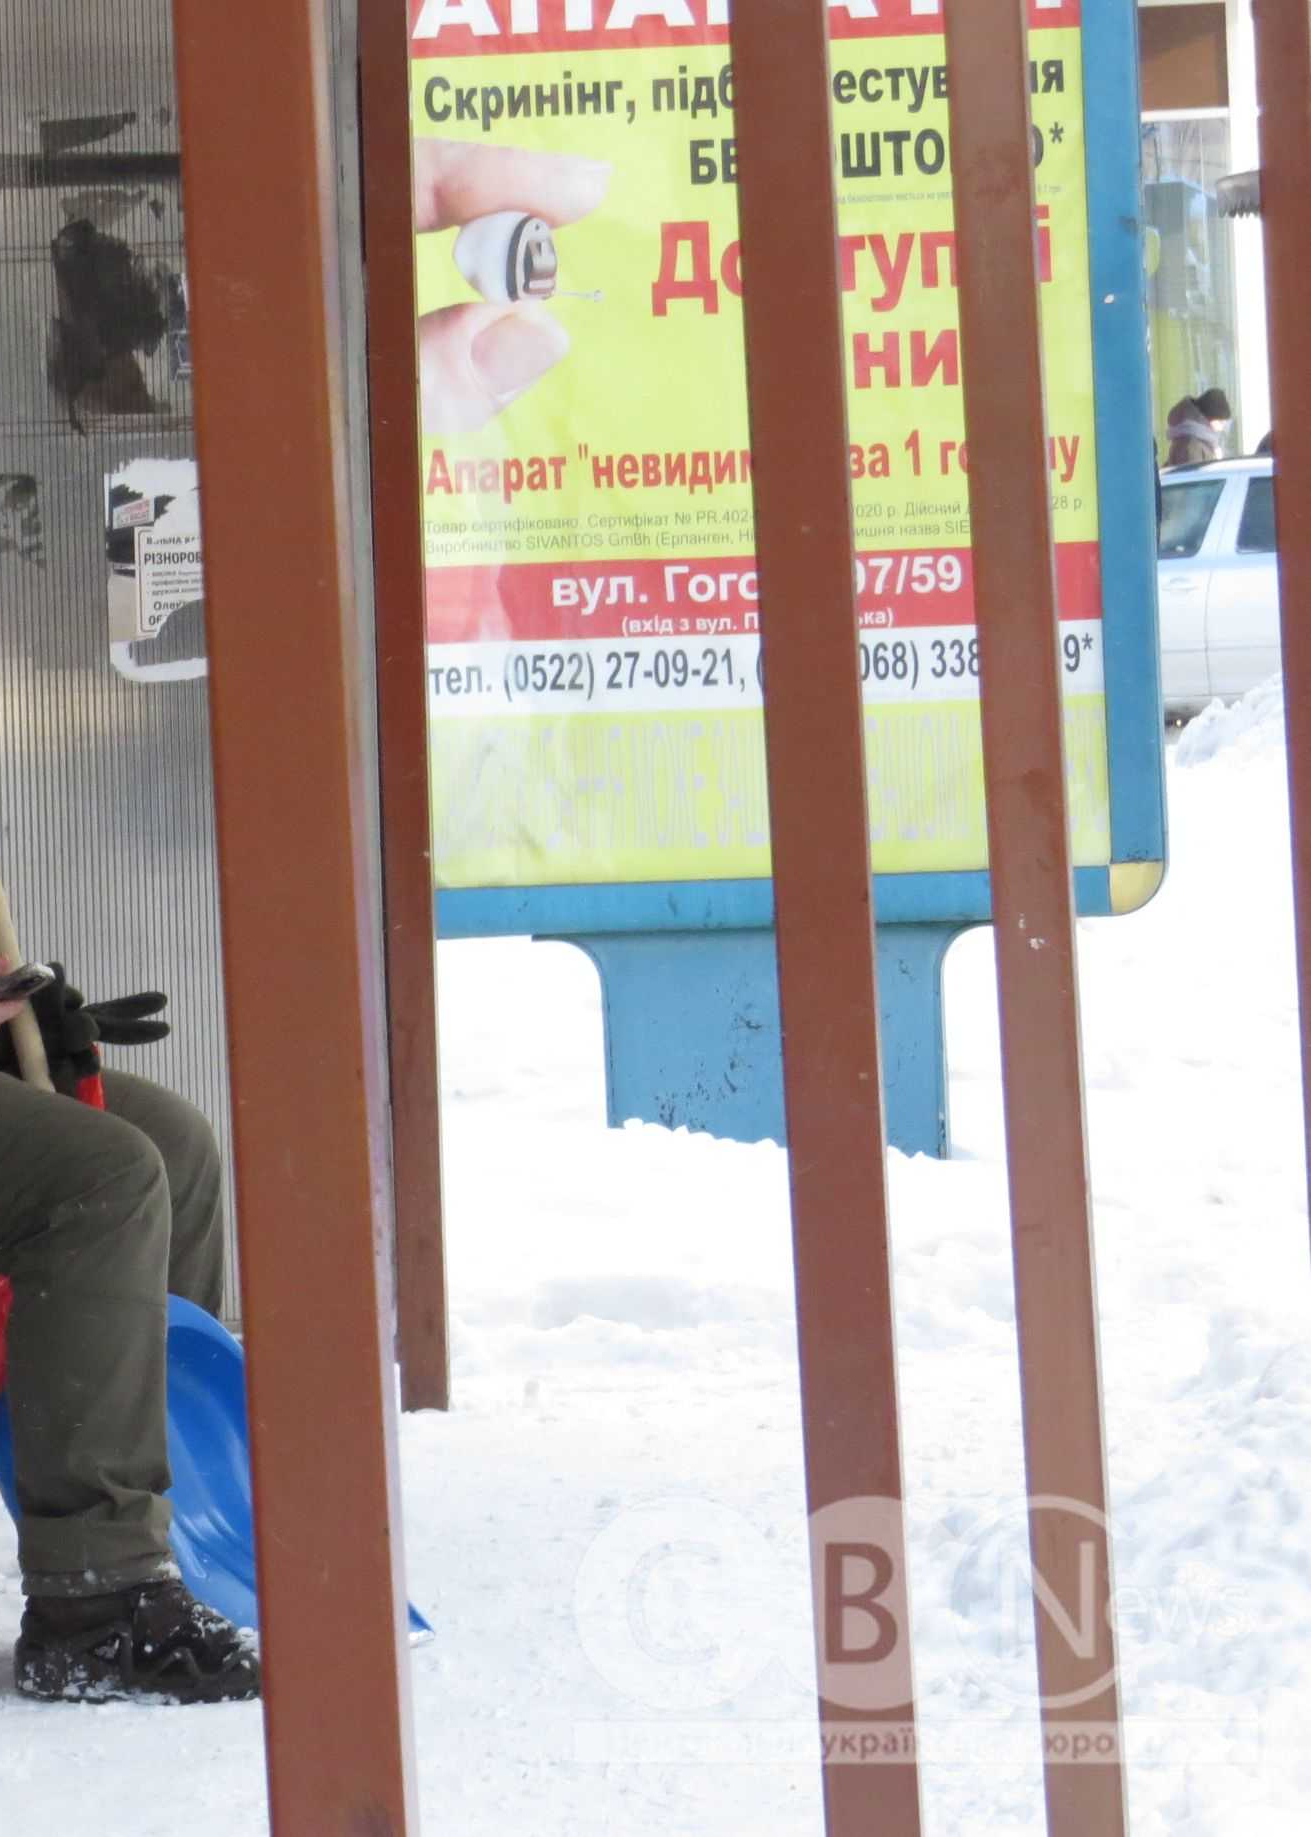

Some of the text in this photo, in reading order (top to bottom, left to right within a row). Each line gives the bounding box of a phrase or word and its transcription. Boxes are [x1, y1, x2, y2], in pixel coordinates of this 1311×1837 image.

[423, 70, 637, 132] Скринінг,
[425, 449, 567, 504] Апарат
[850, 441, 890, 480] за
[904, 429, 922, 477] 1
[586, 511, 670, 530] Сертифікат
[851, 502, 883, 518] 020
[904, 499, 962, 519] Дійсний
[525, 532, 604, 551] SIVANTOS
[899, 524, 941, 537] назва
[551, 574, 648, 616] вул.
[621, 615, 674, 638] (вхід
[678, 618, 690, 633] з
[695, 617, 737, 637] вул.
[428, 665, 492, 696] тел.
[503, 651, 595, 702] (0522)
[605, 647, 746, 692] 27-09-21,
